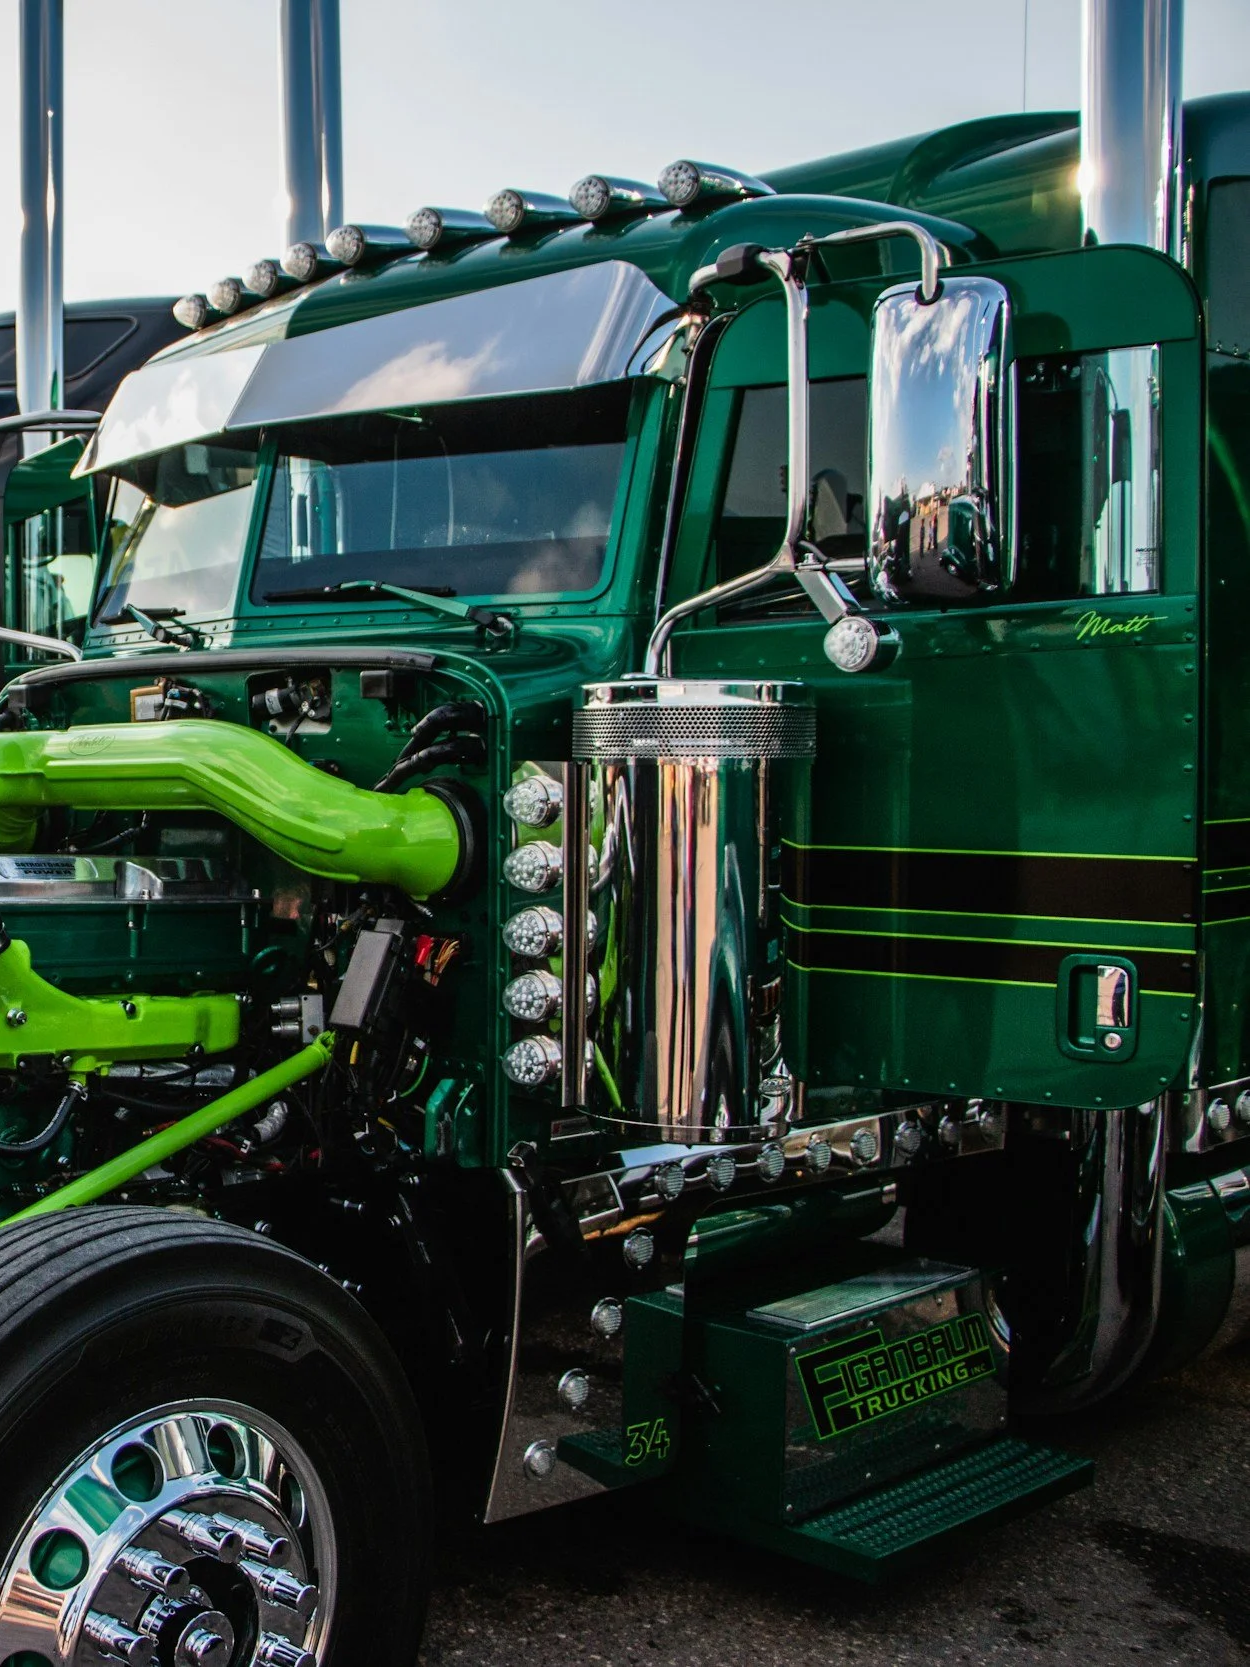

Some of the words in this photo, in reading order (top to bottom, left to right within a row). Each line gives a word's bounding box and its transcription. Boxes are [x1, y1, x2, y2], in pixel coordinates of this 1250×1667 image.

[1075, 611, 1168, 640] Matt
[970, 1363, 987, 1376] INC
[850, 1361, 969, 1421] TRUCKING
[626, 1418, 670, 1466] 34
